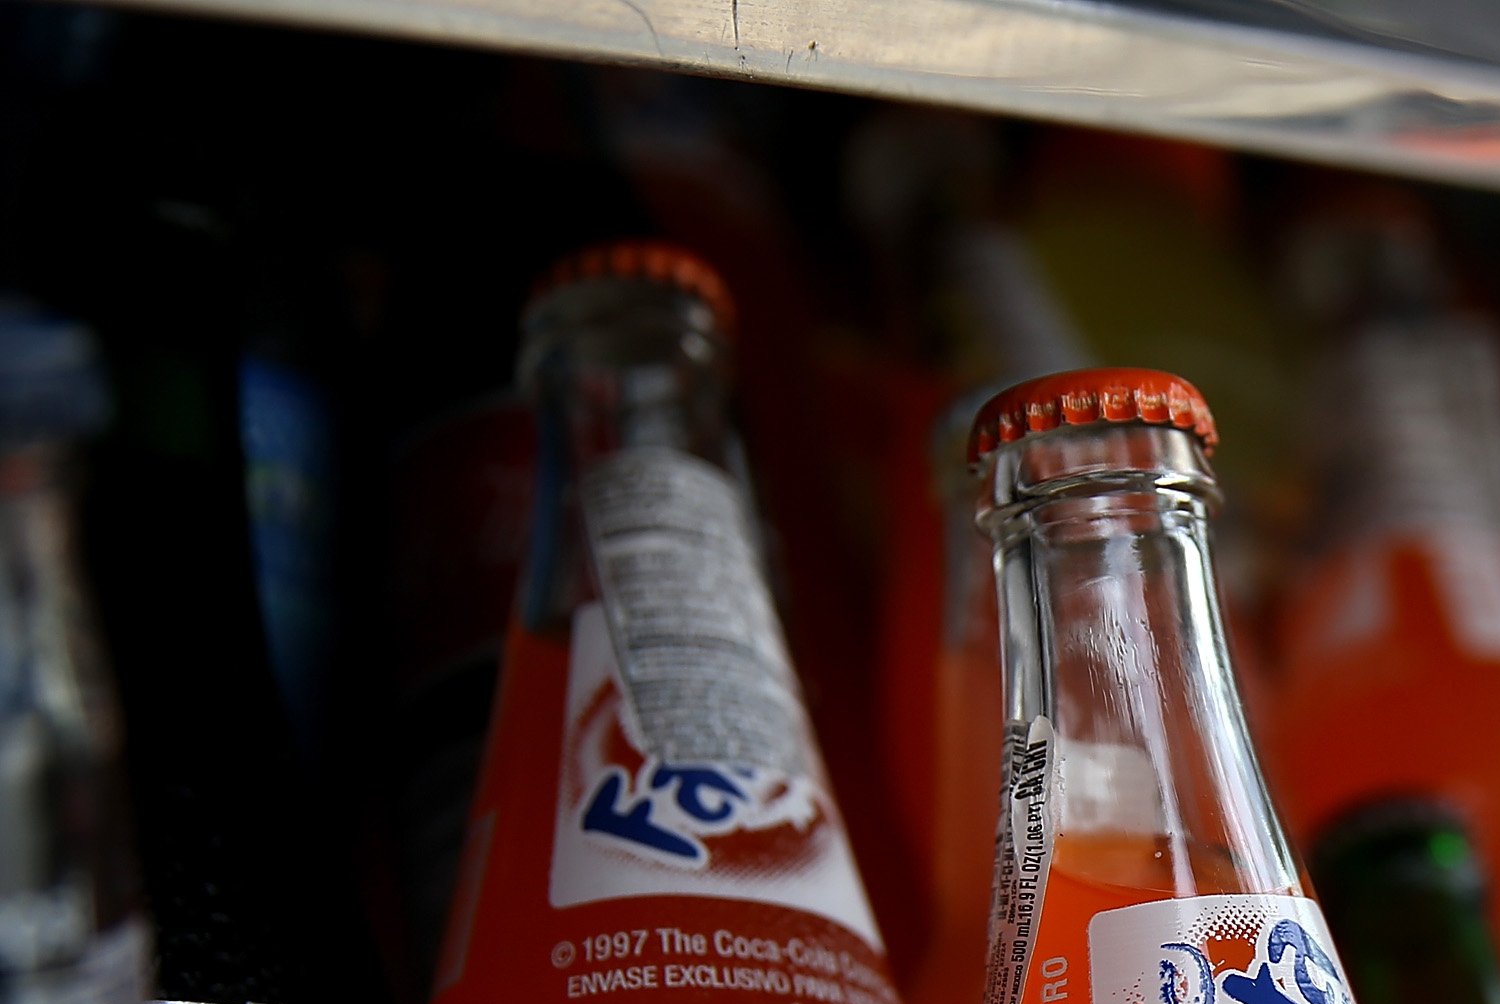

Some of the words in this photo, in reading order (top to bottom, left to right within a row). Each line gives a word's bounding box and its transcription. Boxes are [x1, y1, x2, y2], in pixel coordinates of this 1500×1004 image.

[581, 929, 650, 963] 1997
[656, 927, 708, 957] The
[1011, 940, 1028, 963] 500
[567, 964, 658, 999] ENVASE
[664, 963, 791, 995] EXCLUSIVO
